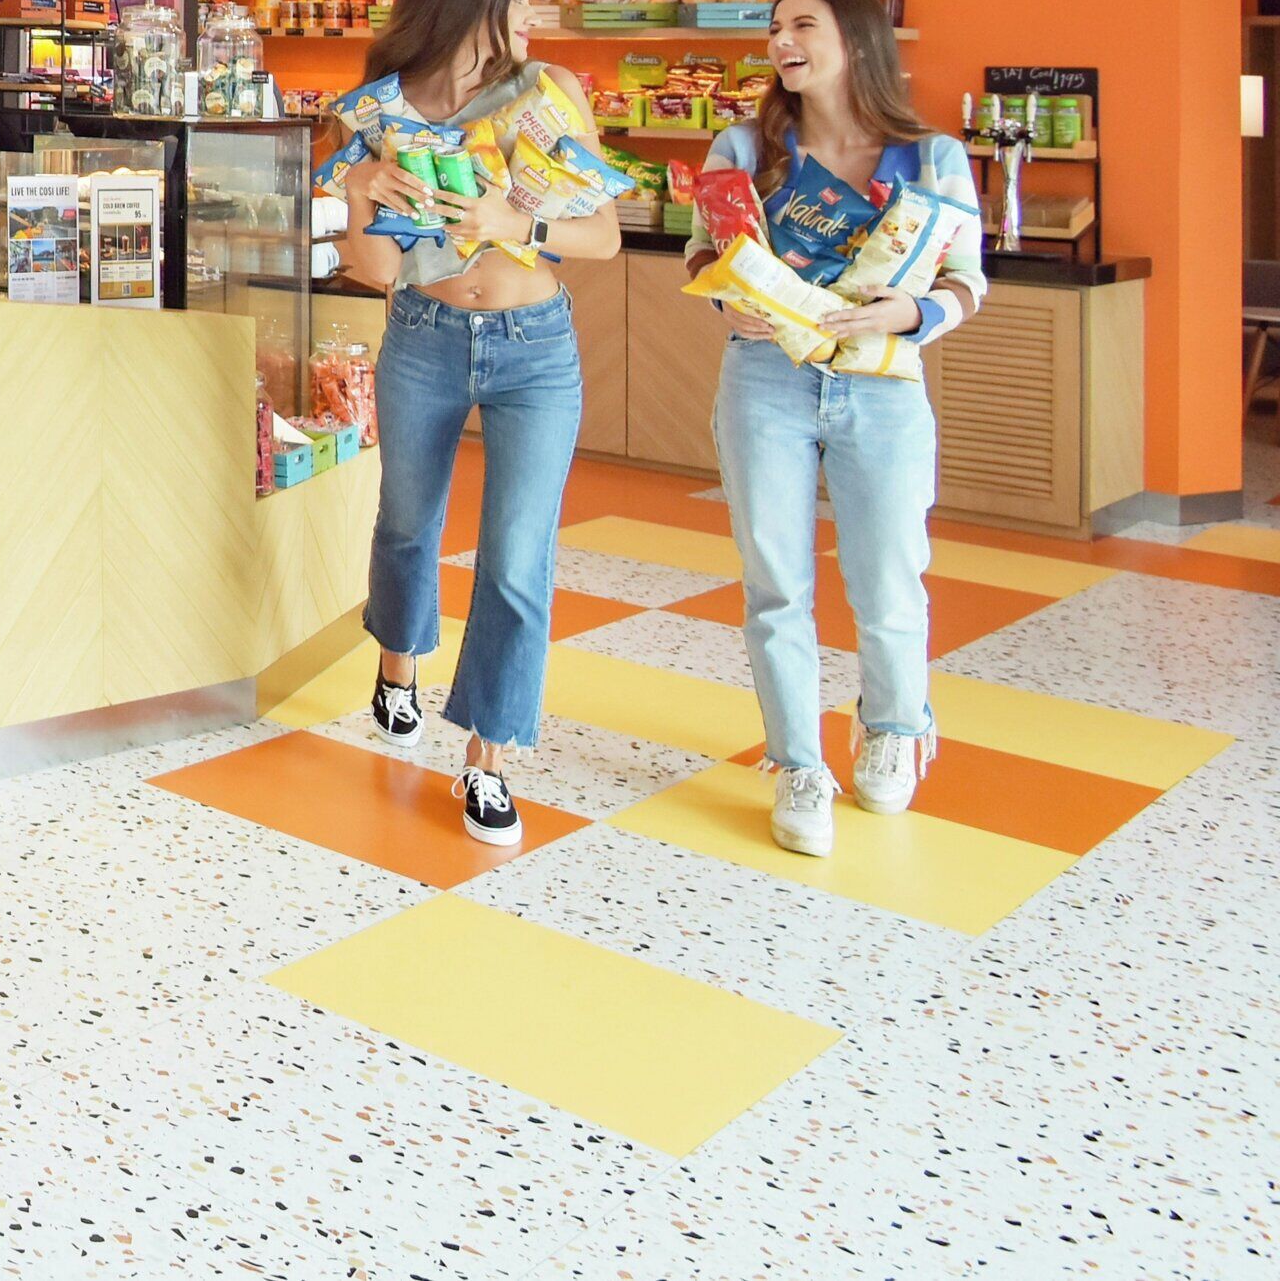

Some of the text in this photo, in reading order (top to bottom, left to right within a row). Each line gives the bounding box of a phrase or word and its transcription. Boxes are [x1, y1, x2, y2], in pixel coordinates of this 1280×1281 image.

[522, 110, 554, 148] CHEESE
[11, 186, 24, 196] LIVE
[26, 187, 37, 196] THE
[40, 186, 54, 196] COSI
[512, 180, 544, 208] HEESE
